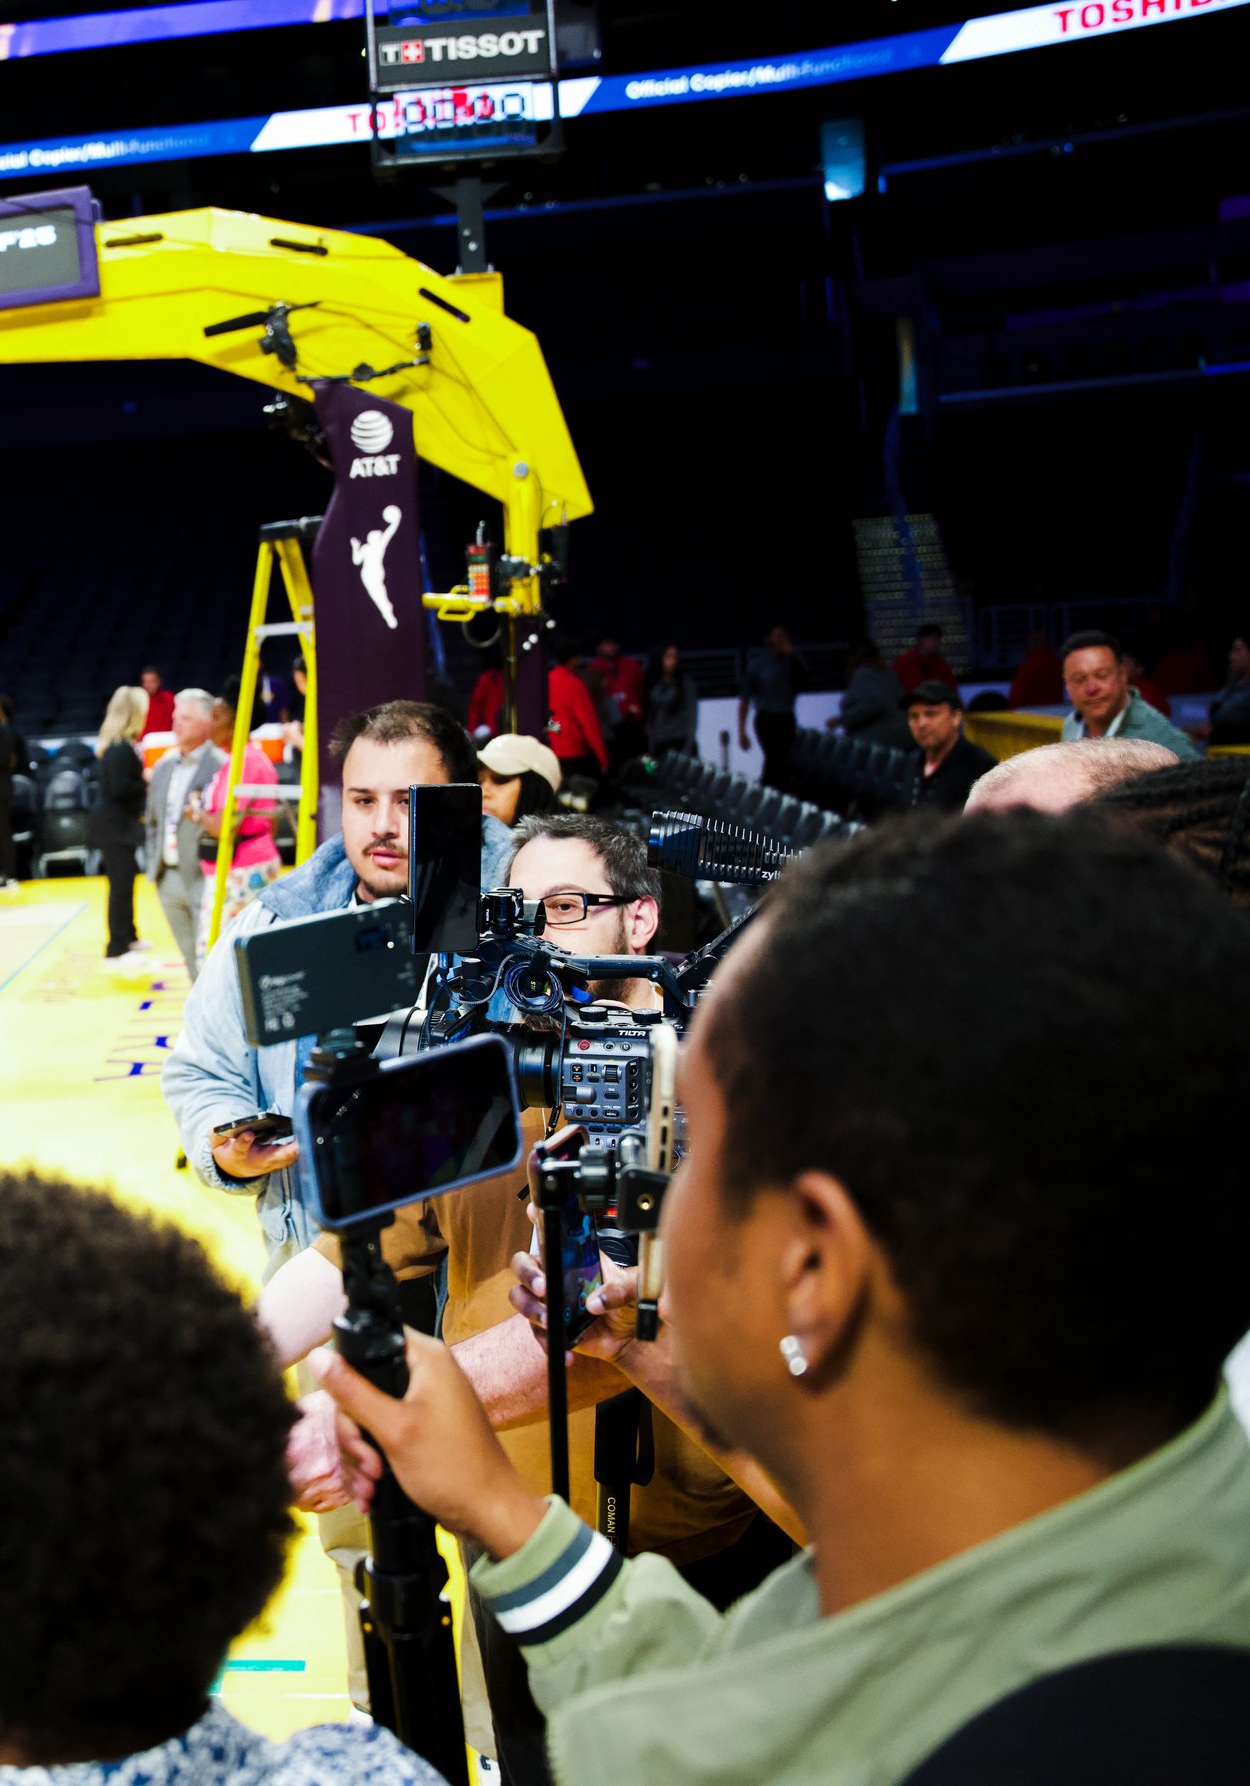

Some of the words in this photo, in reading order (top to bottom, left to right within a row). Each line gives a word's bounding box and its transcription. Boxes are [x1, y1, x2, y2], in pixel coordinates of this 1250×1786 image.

[1055, 0, 1223, 32] TOSH
[424, 30, 544, 61] TISSOT
[624, 75, 689, 100] Official
[349, 453, 401, 479] AT&T
[618, 1029, 647, 1037] TILTA
[607, 1496, 616, 1534] COMAN
